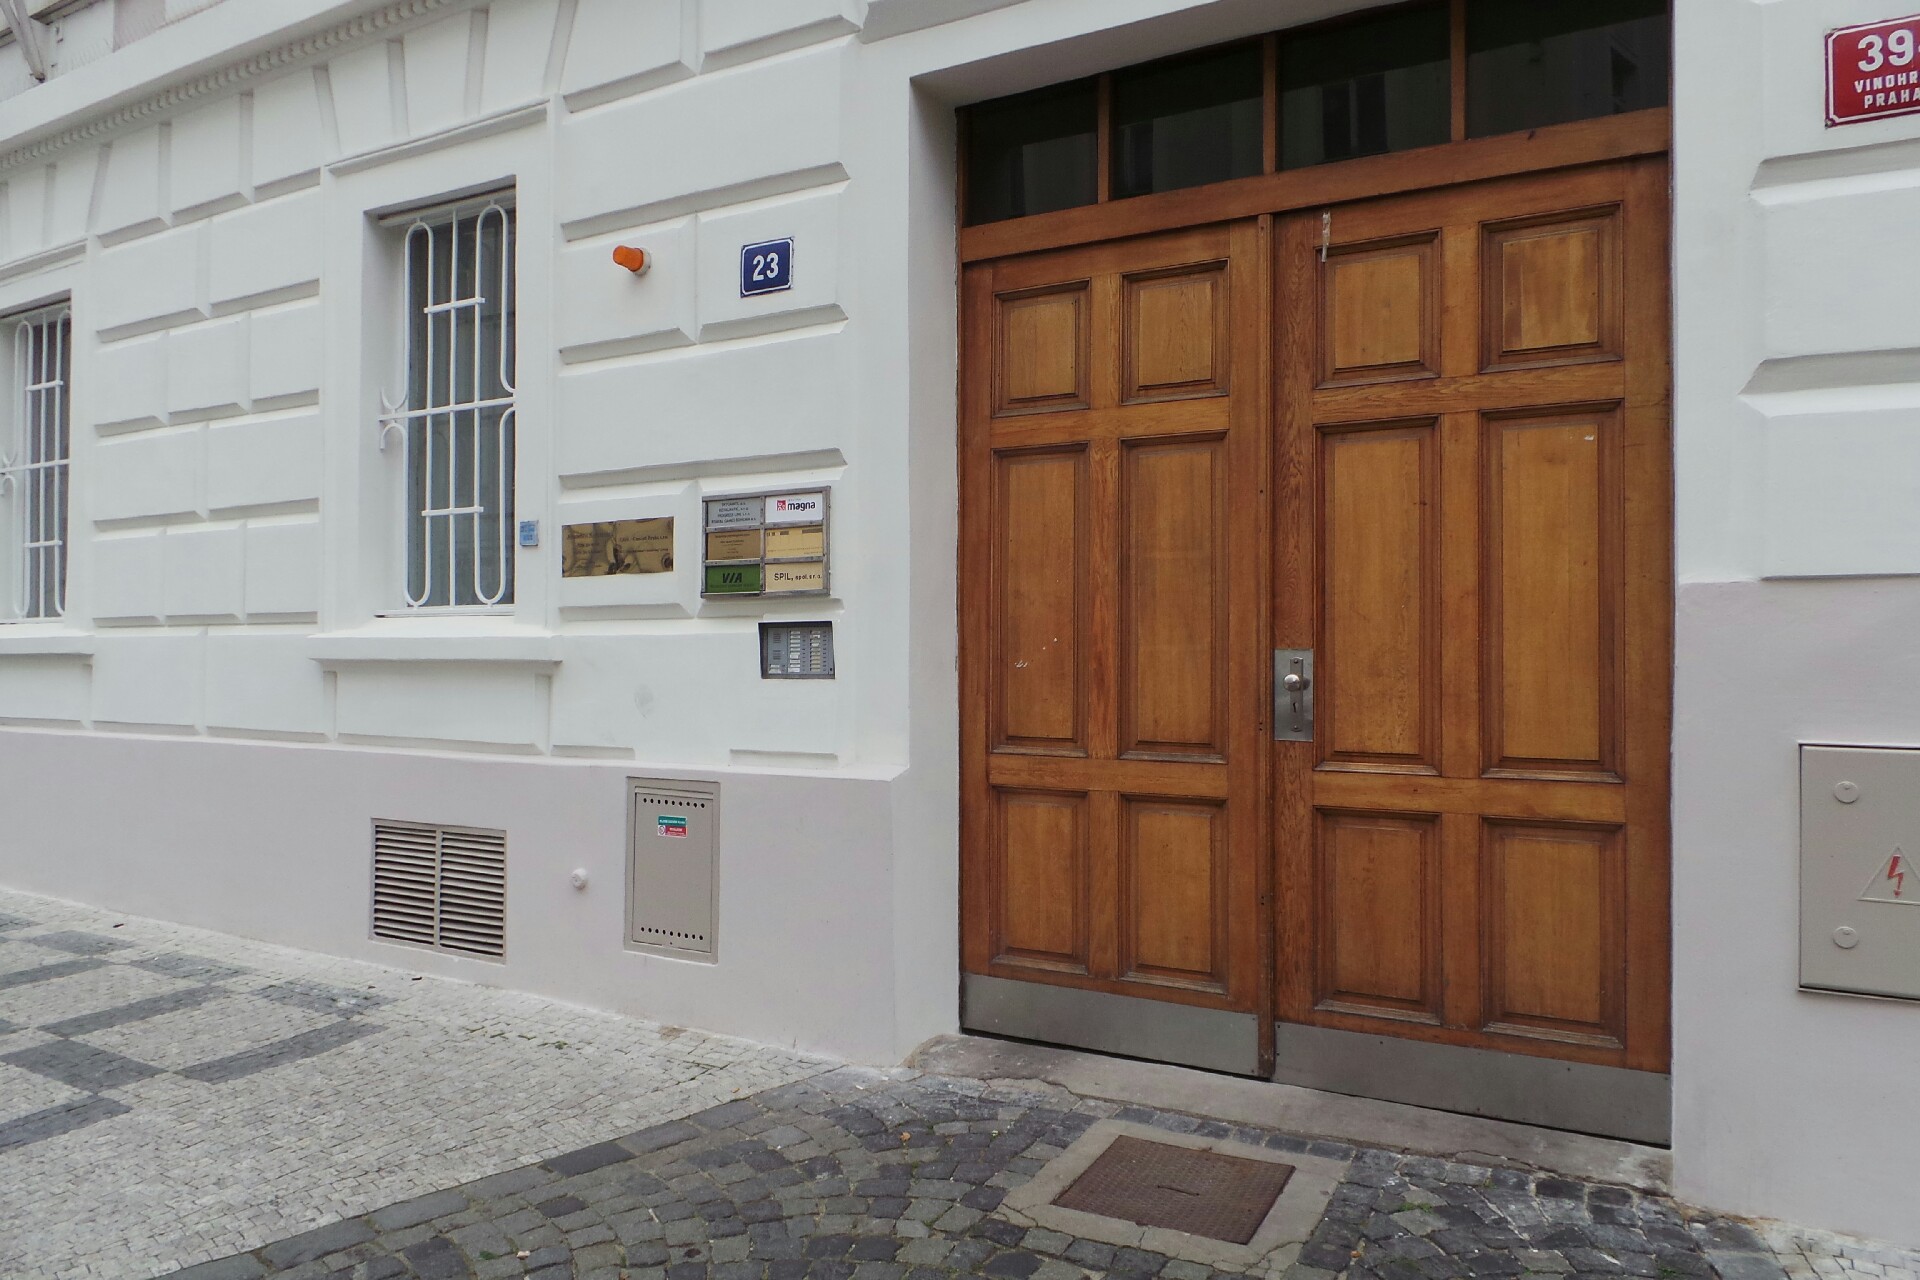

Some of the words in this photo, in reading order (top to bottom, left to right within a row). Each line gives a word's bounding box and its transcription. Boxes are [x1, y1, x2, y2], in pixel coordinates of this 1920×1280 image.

[1857, 29, 1920, 72] 39
[1864, 87, 1920, 109] PRAHA
[752, 252, 779, 281] 23
[787, 501, 816, 512] magna
[722, 572, 743, 584] VIA
[774, 572, 794, 582] SPIL,
